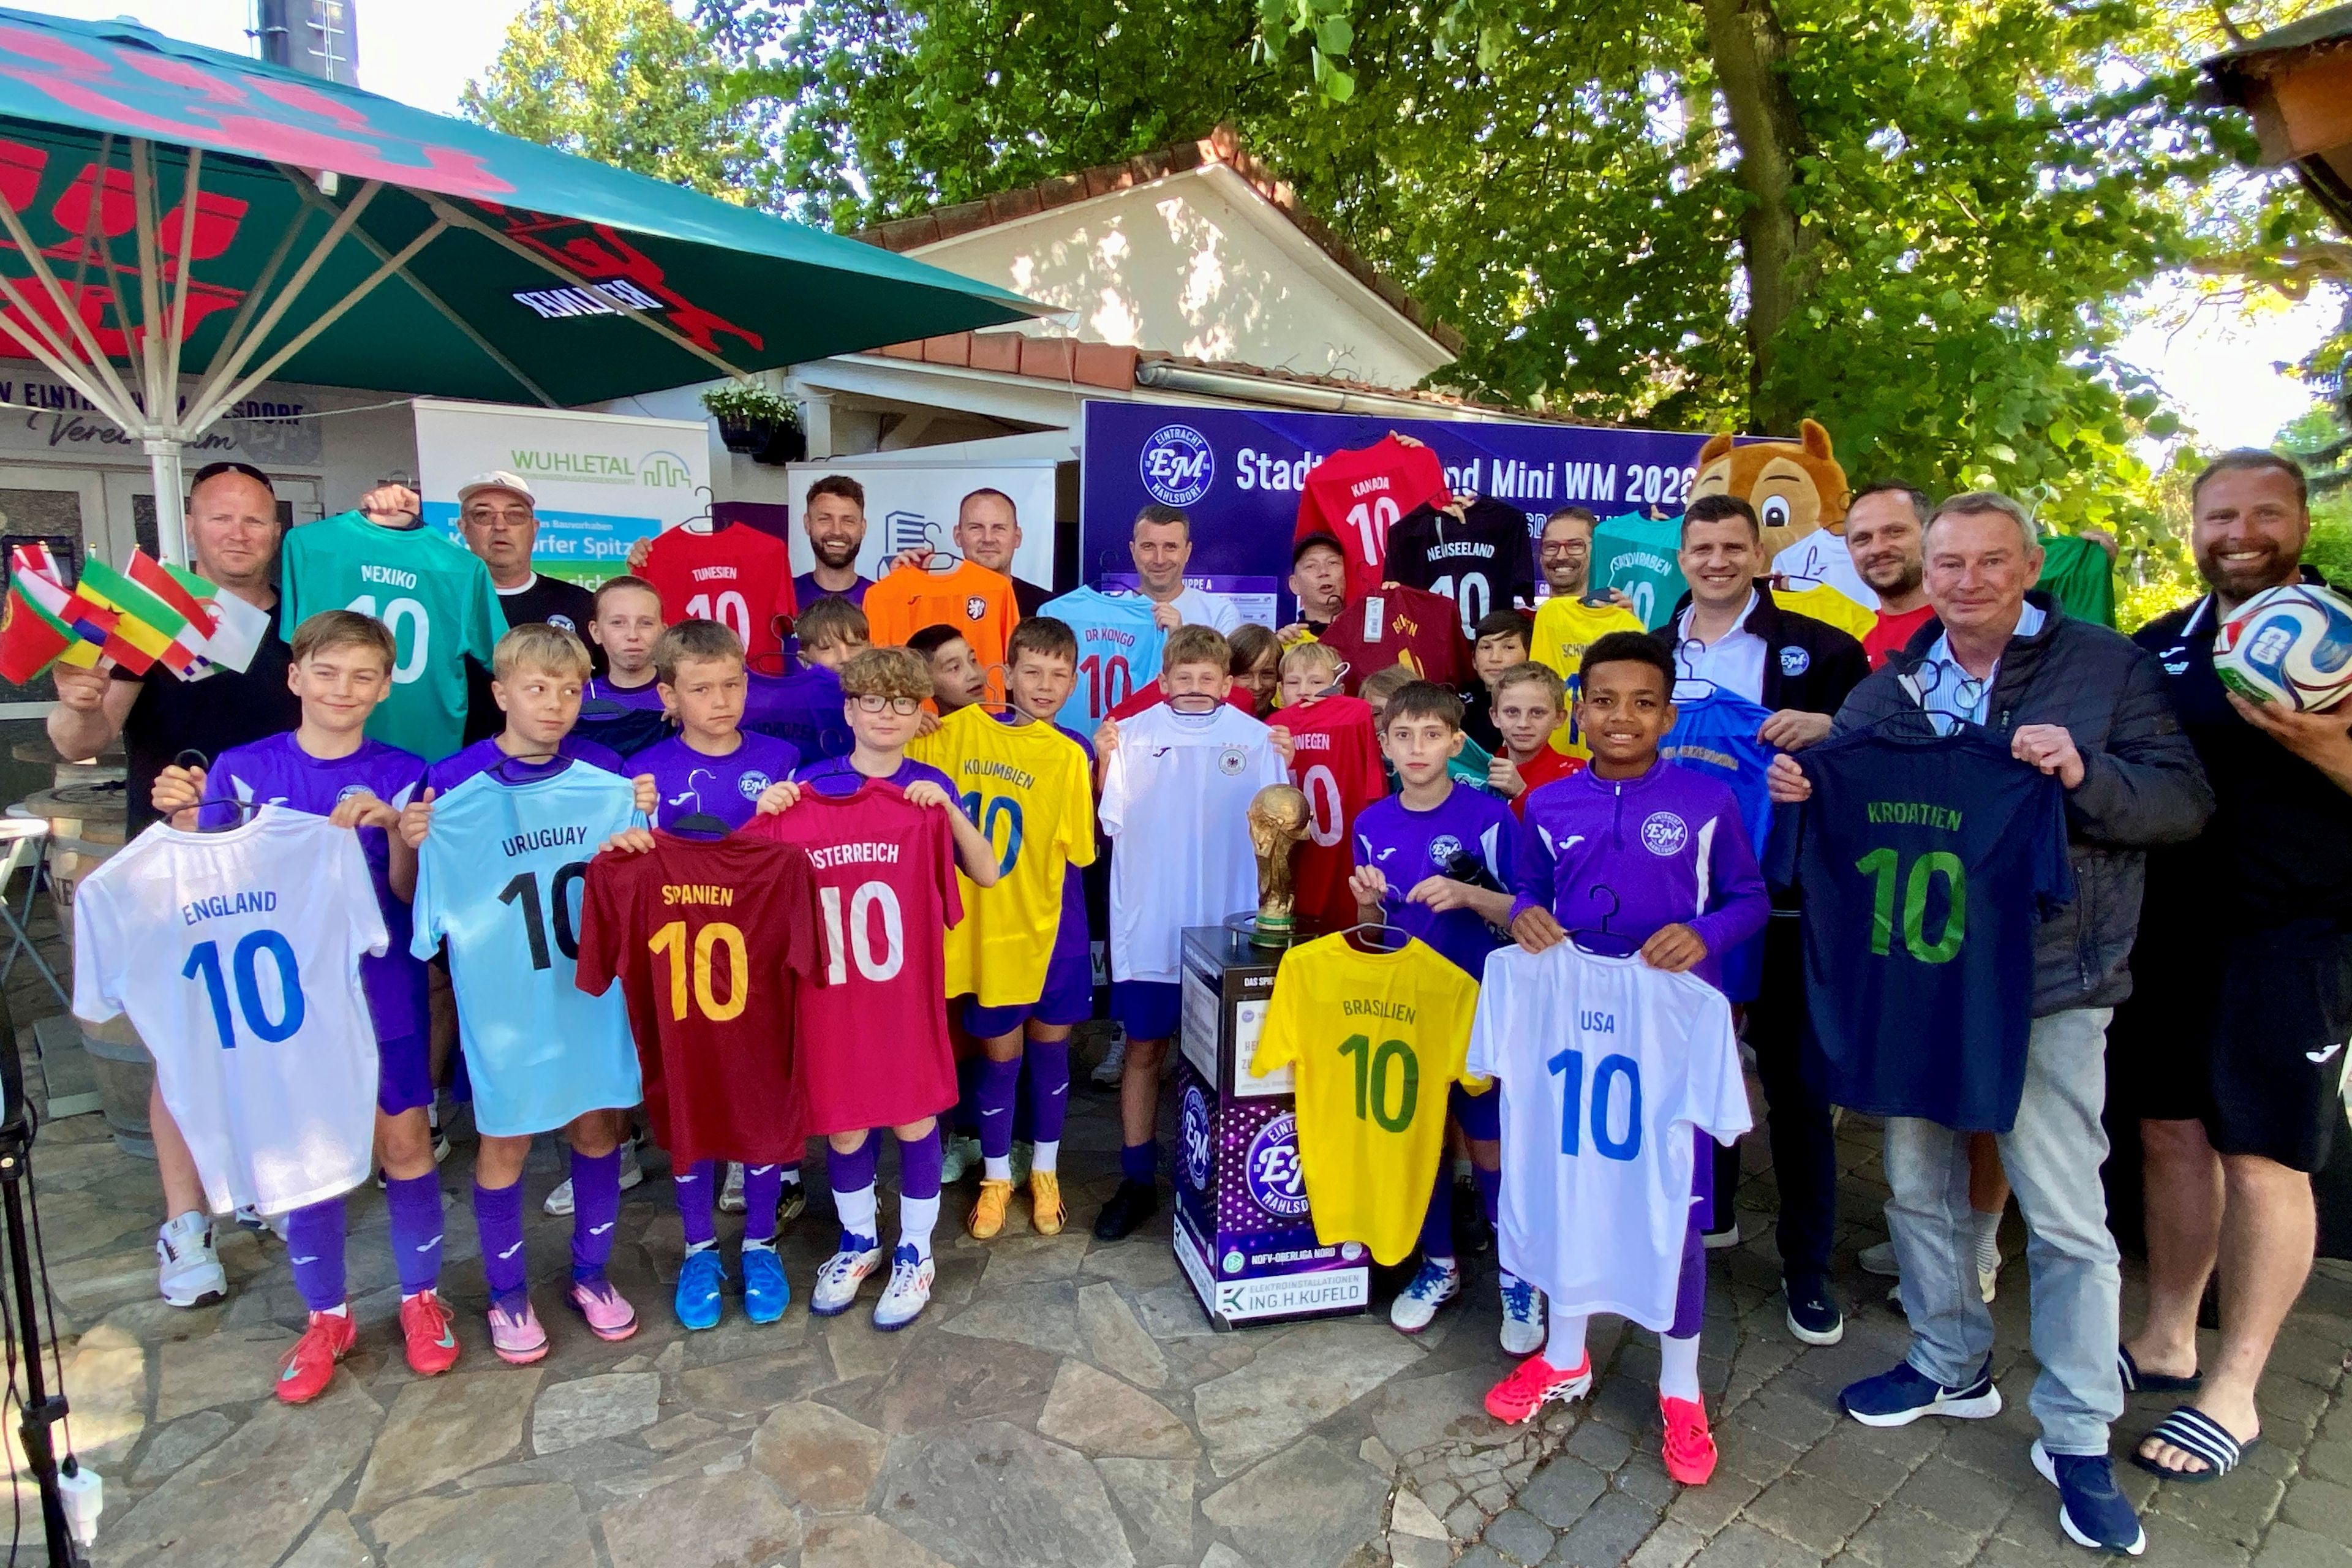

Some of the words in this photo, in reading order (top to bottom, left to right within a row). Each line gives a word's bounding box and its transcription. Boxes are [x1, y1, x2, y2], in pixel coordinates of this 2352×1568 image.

[1155, 428, 1203, 447] EINTRACHT
[511, 450, 635, 475] WUHLETAL
[1148, 448, 1207, 487] EM
[1236, 448, 1325, 491] Stadt
[1443, 458, 1480, 497] nd
[1491, 459, 1555, 499] Mini
[1565, 462, 1616, 501] WM
[1151, 483, 1201, 503] MAHLSDORF
[1351, 477, 1390, 498] KANADA
[1346, 496, 1401, 567] 10
[584, 537, 633, 558] Spitz
[1427, 541, 1495, 562] NEUSEELAND
[692, 566, 737, 582] TUNESIEN
[1182, 578, 1204, 590] UPPE
[1205, 579, 1212, 590] A
[1085, 628, 1099, 642] DR
[1101, 628, 1135, 647] KONGO
[1079, 655, 1131, 718] 10
[1294, 733, 1330, 750] WEGEN
[964, 759, 1036, 790] KOLUMBIEN
[1288, 764, 1344, 847] 0
[1868, 801, 1962, 832] KROATIEN
[502, 826, 587, 857] URUGUAY
[1647, 823, 1683, 844] EM
[805, 842, 899, 870] STERREICH
[182, 891, 277, 926] ENGLAND
[662, 884, 734, 907] SPANIEN
[1855, 848, 1966, 964] 10
[497, 862, 589, 970] 10
[820, 881, 904, 985] 10
[648, 921, 749, 1022] 10
[1244, 977, 1258, 987] DAS
[181, 929, 306, 1049] 10
[1343, 1000, 1416, 1025] BRASILIEN
[1581, 1009, 1615, 1034] USA
[1336, 1033, 1420, 1133] 10
[1547, 1048, 1643, 1162] 10
[1262, 1191, 1309, 1214] MAHLSD
[1250, 1274, 1360, 1294] ELEKTROINSTALLATIONEN
